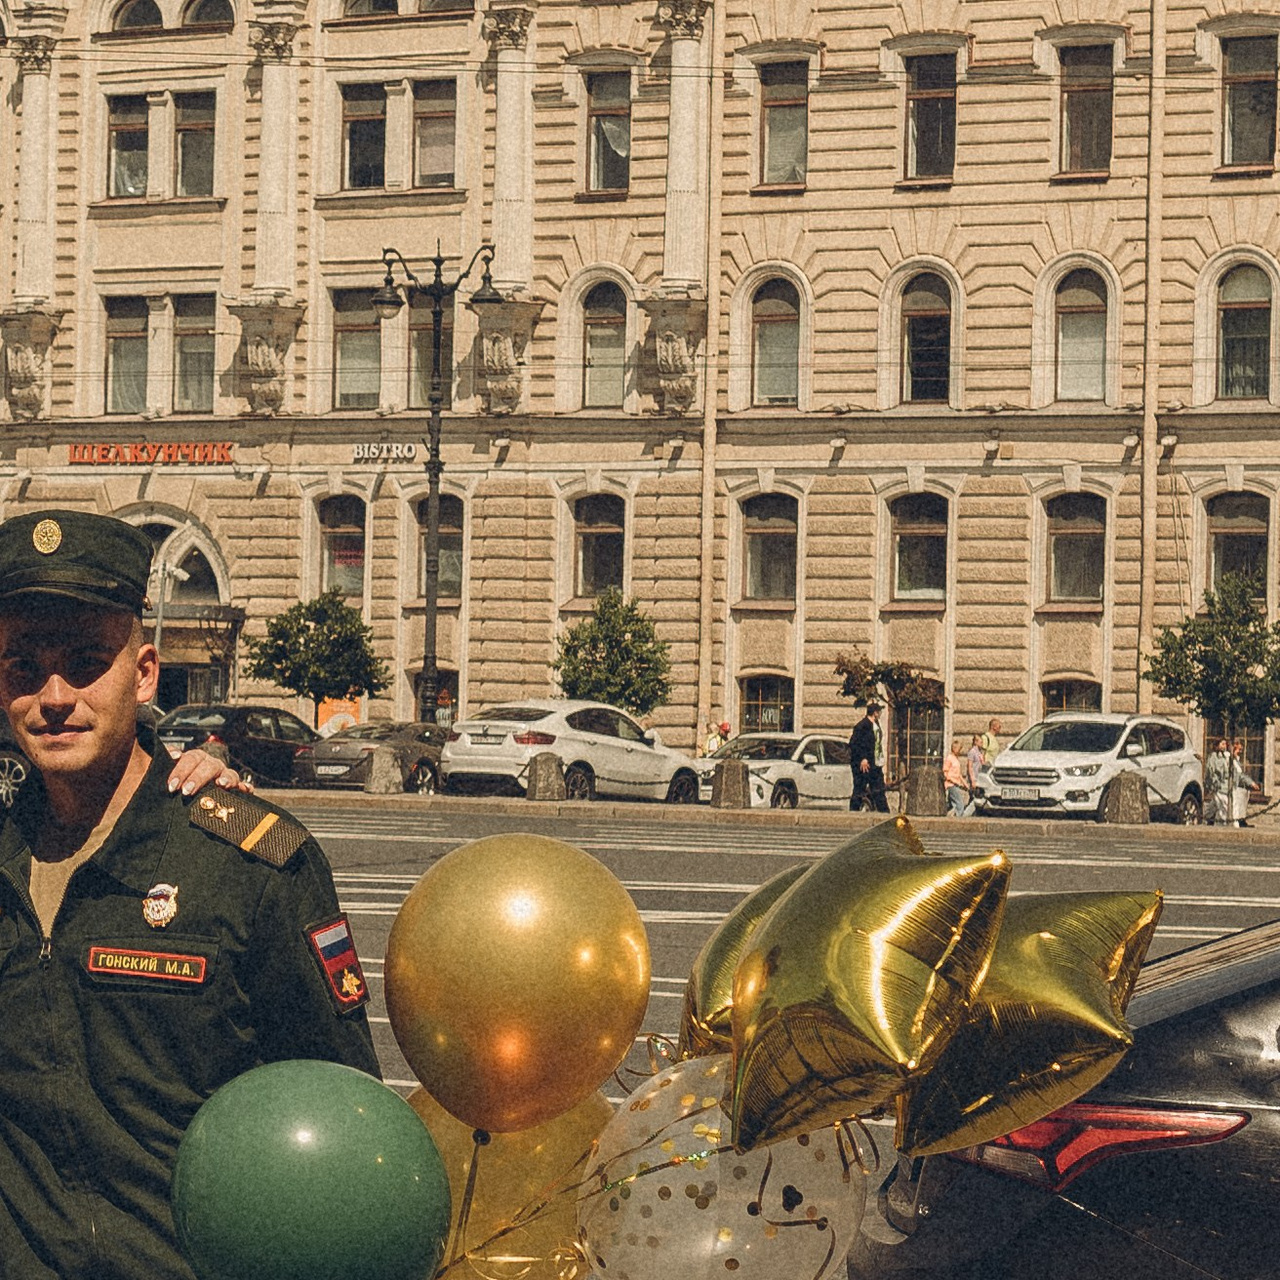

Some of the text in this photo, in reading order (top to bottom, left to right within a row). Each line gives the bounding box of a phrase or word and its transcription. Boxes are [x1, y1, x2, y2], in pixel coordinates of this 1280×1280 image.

[69, 442, 234, 463] ЩЕЛКУНЧИК
[354, 443, 417, 459] BISTRO
[98, 954, 194, 976] ГОНСКИЙ М.А.
